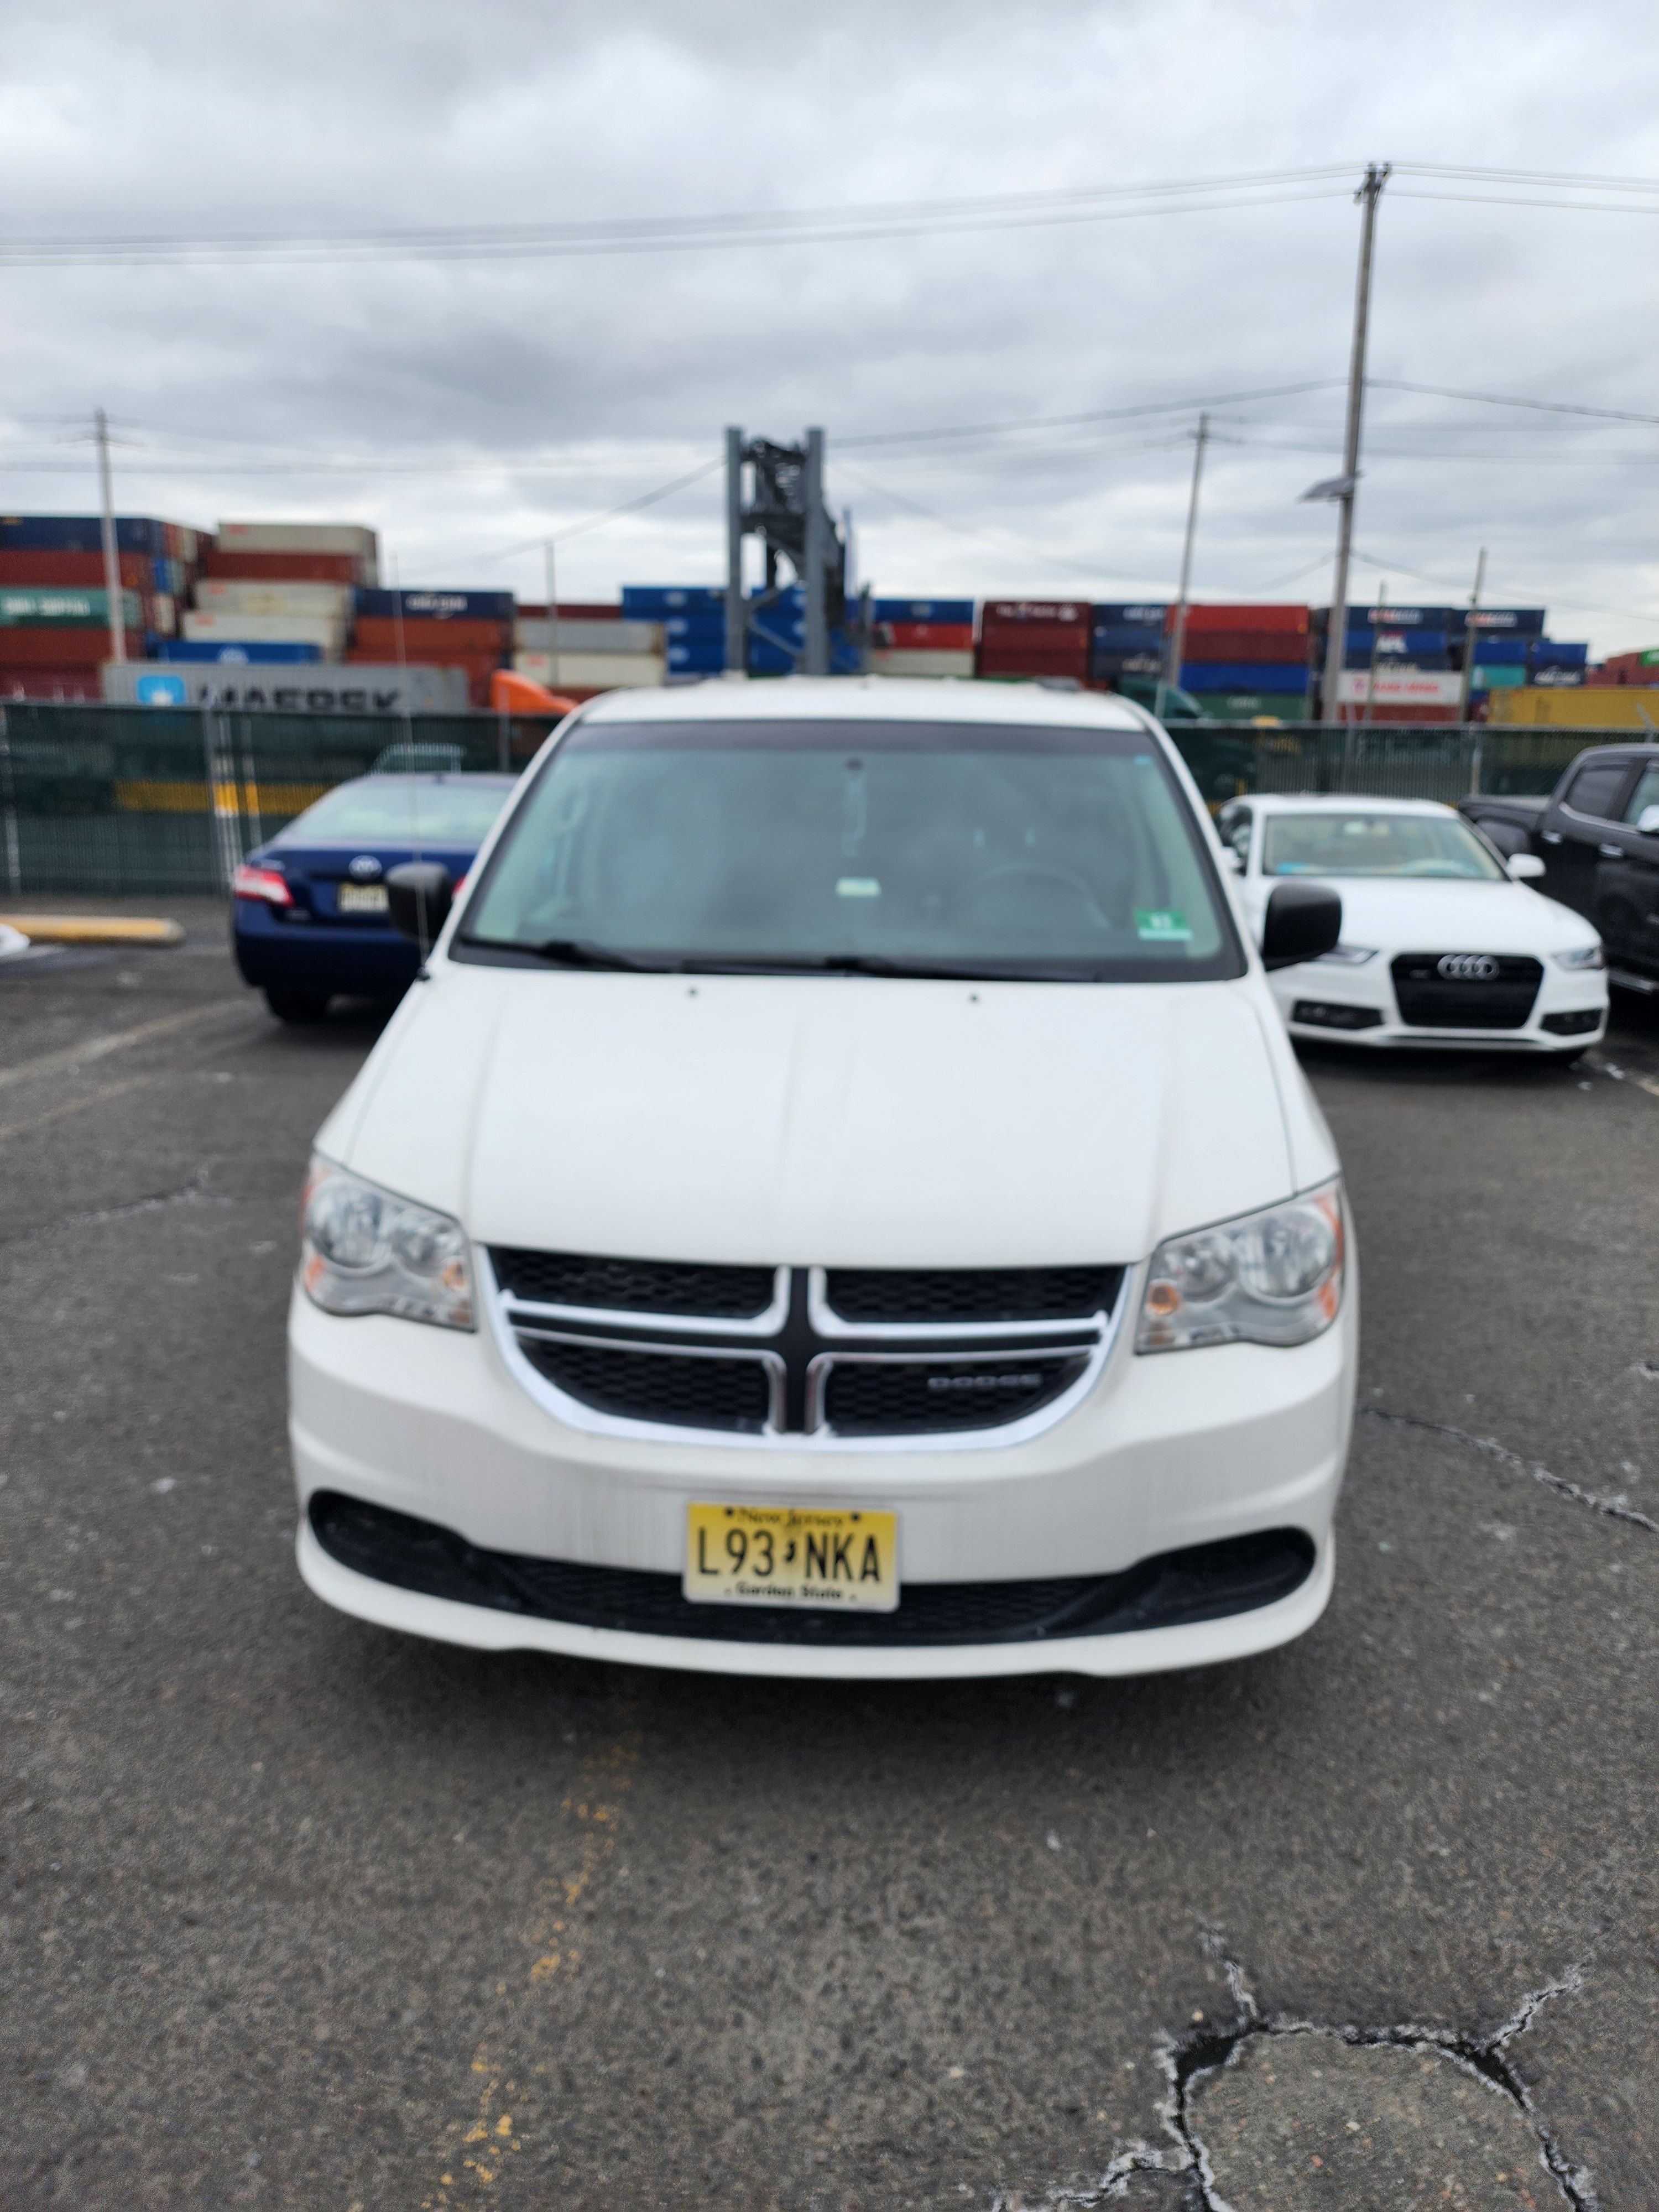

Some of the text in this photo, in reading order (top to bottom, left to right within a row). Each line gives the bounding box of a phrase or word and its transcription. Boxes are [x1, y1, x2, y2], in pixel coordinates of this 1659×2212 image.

[738, 1506, 844, 1528] New Jersey
[697, 1526, 881, 1582] L93 NKA
[735, 1582, 843, 1600] Garden State
